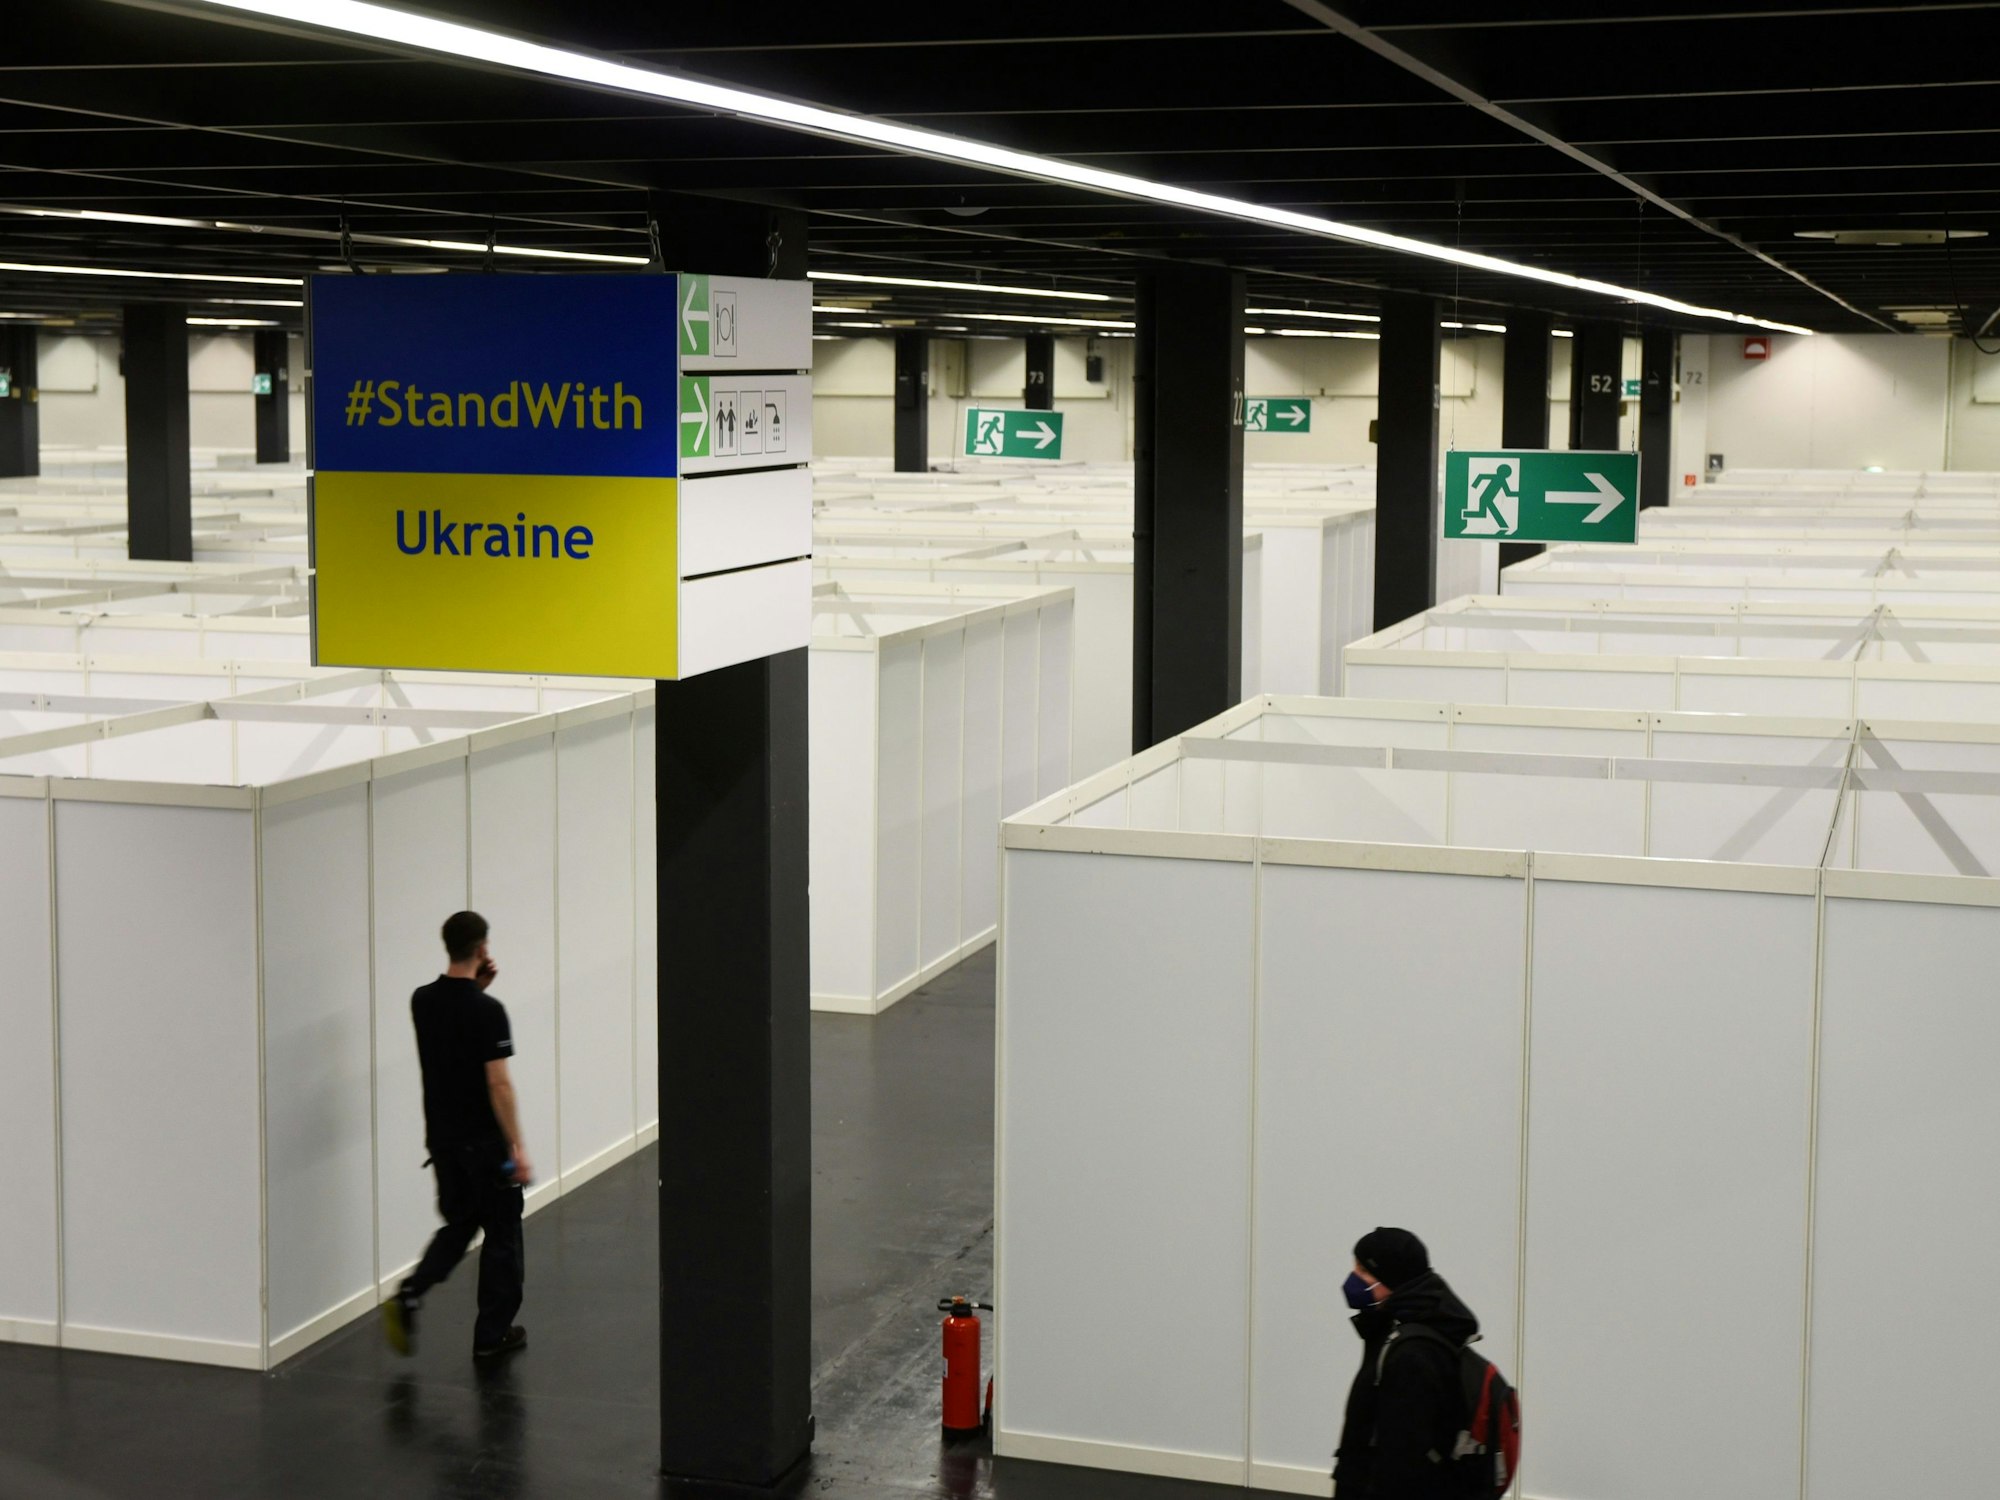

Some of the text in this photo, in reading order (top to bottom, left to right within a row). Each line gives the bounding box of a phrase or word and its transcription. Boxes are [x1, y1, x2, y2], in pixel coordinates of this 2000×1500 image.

[1029, 371, 1045, 384] 73
[1591, 375, 1612, 393] 52
[1686, 371, 1703, 384] 72
[345, 380, 643, 429] #StandWith
[396, 510, 594, 559] Ukraine
